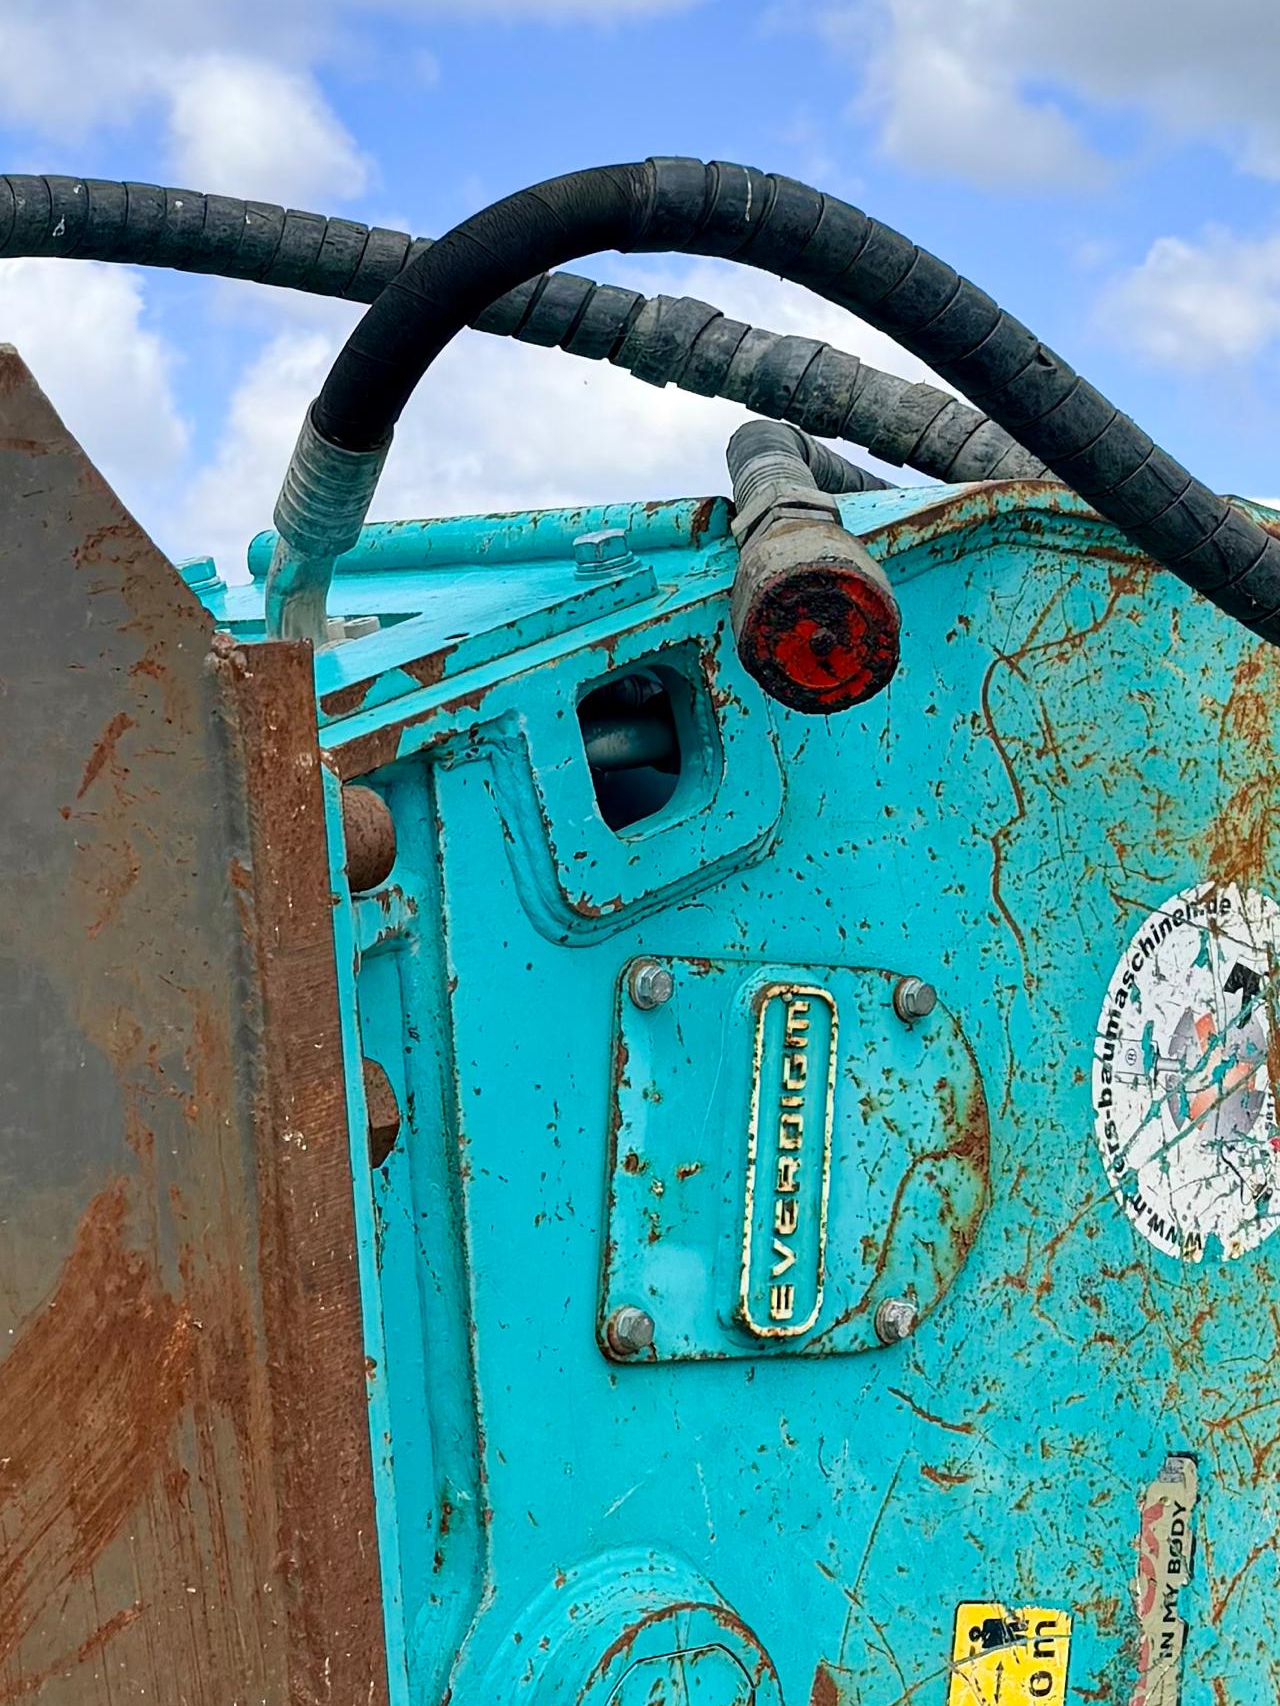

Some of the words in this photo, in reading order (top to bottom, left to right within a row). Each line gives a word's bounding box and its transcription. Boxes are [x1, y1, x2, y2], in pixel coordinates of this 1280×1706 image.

[771, 1000, 810, 1319] EVERDIGM
[1168, 1500, 1186, 1574] BODY
[1163, 1583, 1178, 1623] MY
[1160, 1632, 1175, 1658] IN
